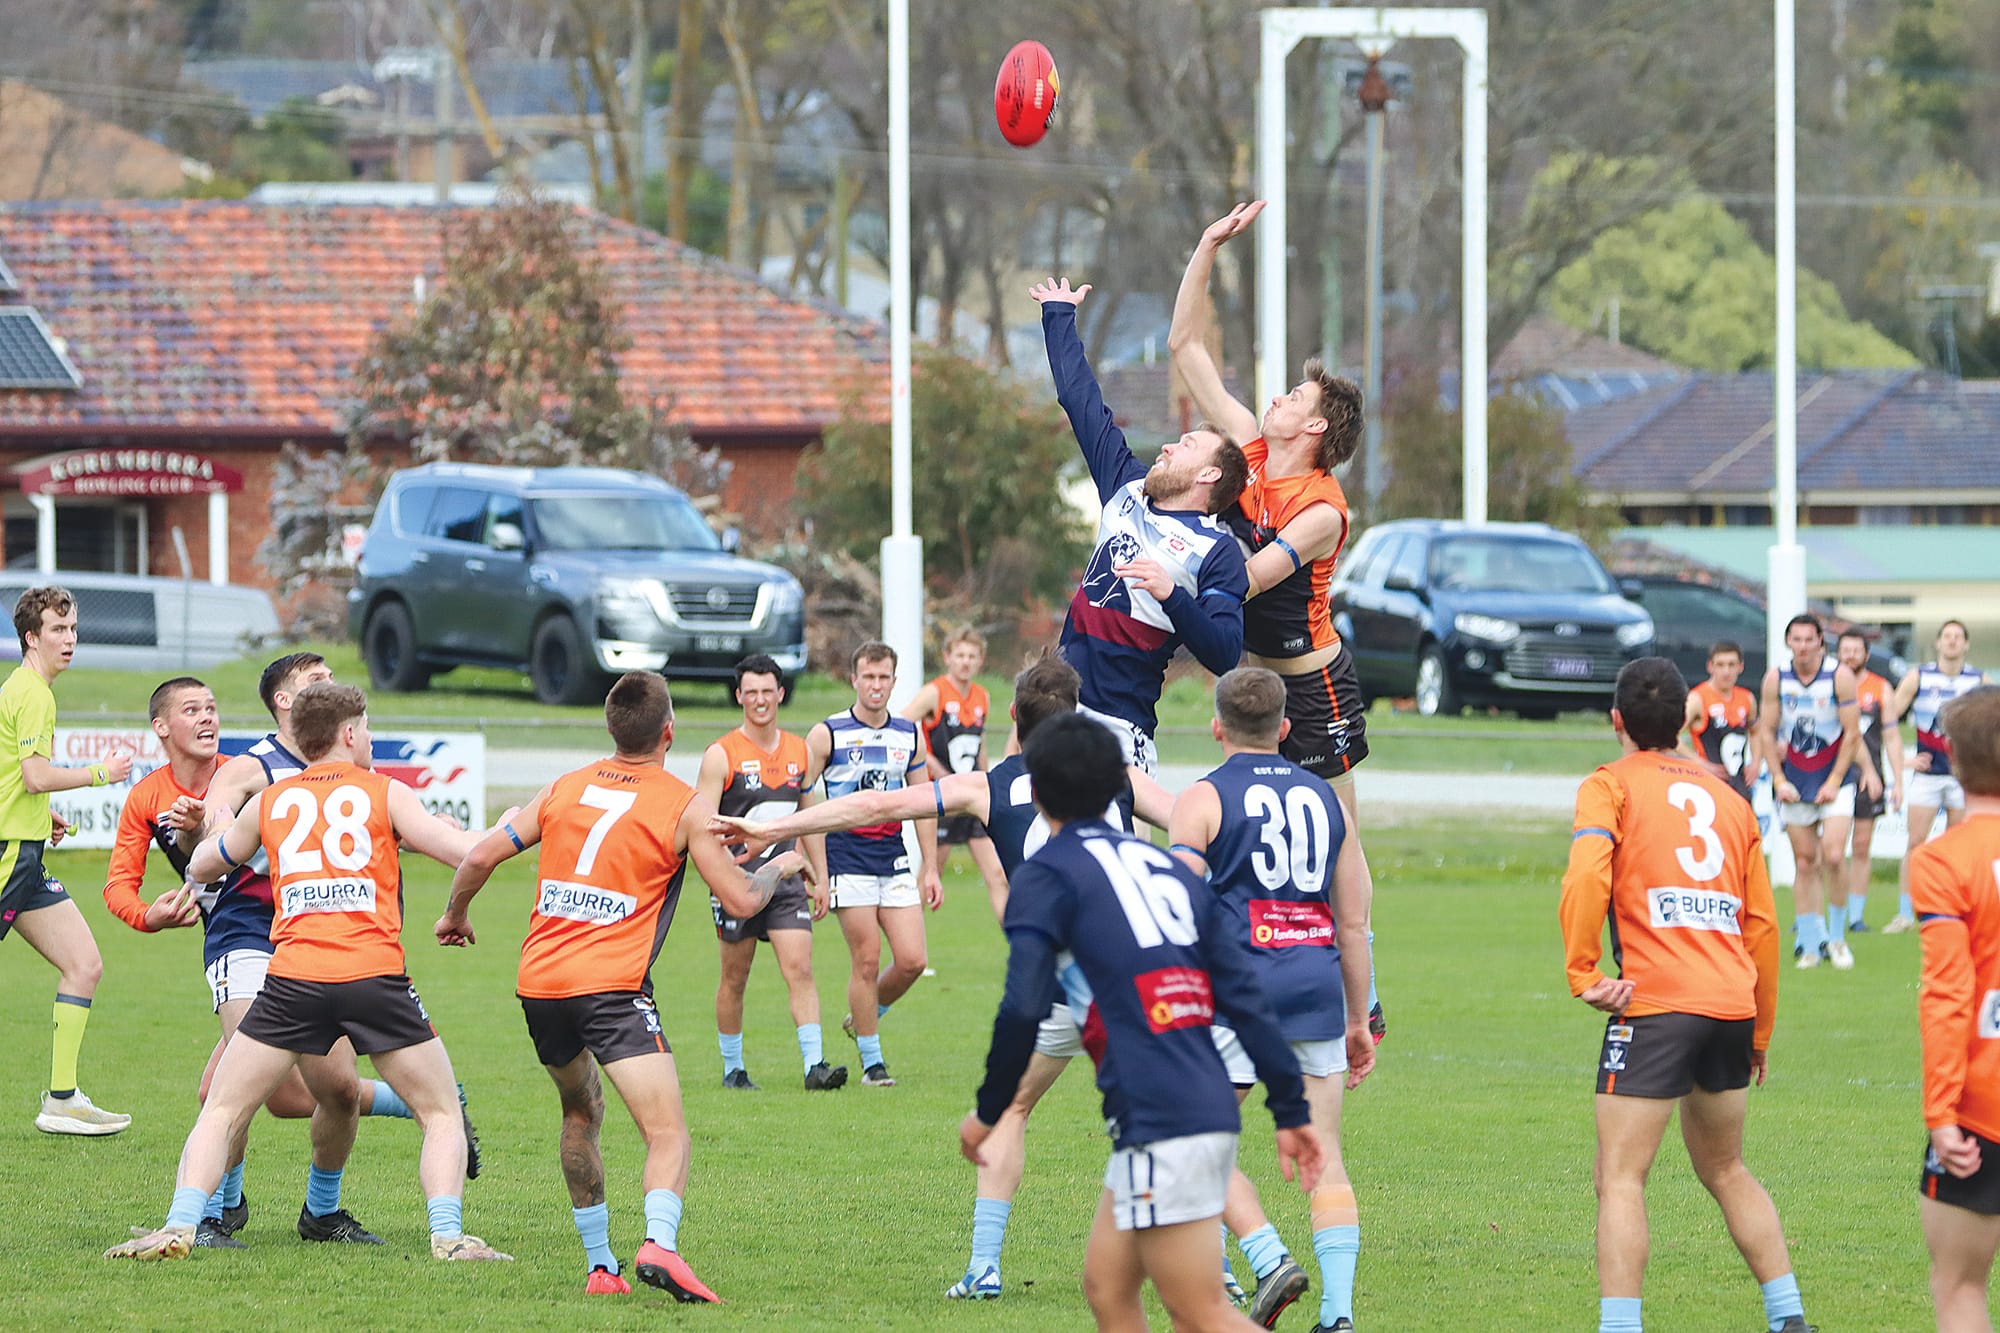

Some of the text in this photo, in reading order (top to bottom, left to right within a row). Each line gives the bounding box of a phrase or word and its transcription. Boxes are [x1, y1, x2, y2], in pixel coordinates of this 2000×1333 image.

[51, 450, 213, 480] KORUMBURRA
[75, 476, 193, 493] BOWLING CLUB
[270, 784, 373, 878] 28
[574, 784, 638, 876] 7
[1244, 784, 1330, 892] 30
[1667, 781, 1725, 881] 3
[303, 883, 369, 901] BURRA
[560, 889, 627, 917] BURRA
[1082, 837, 1199, 949] 16
